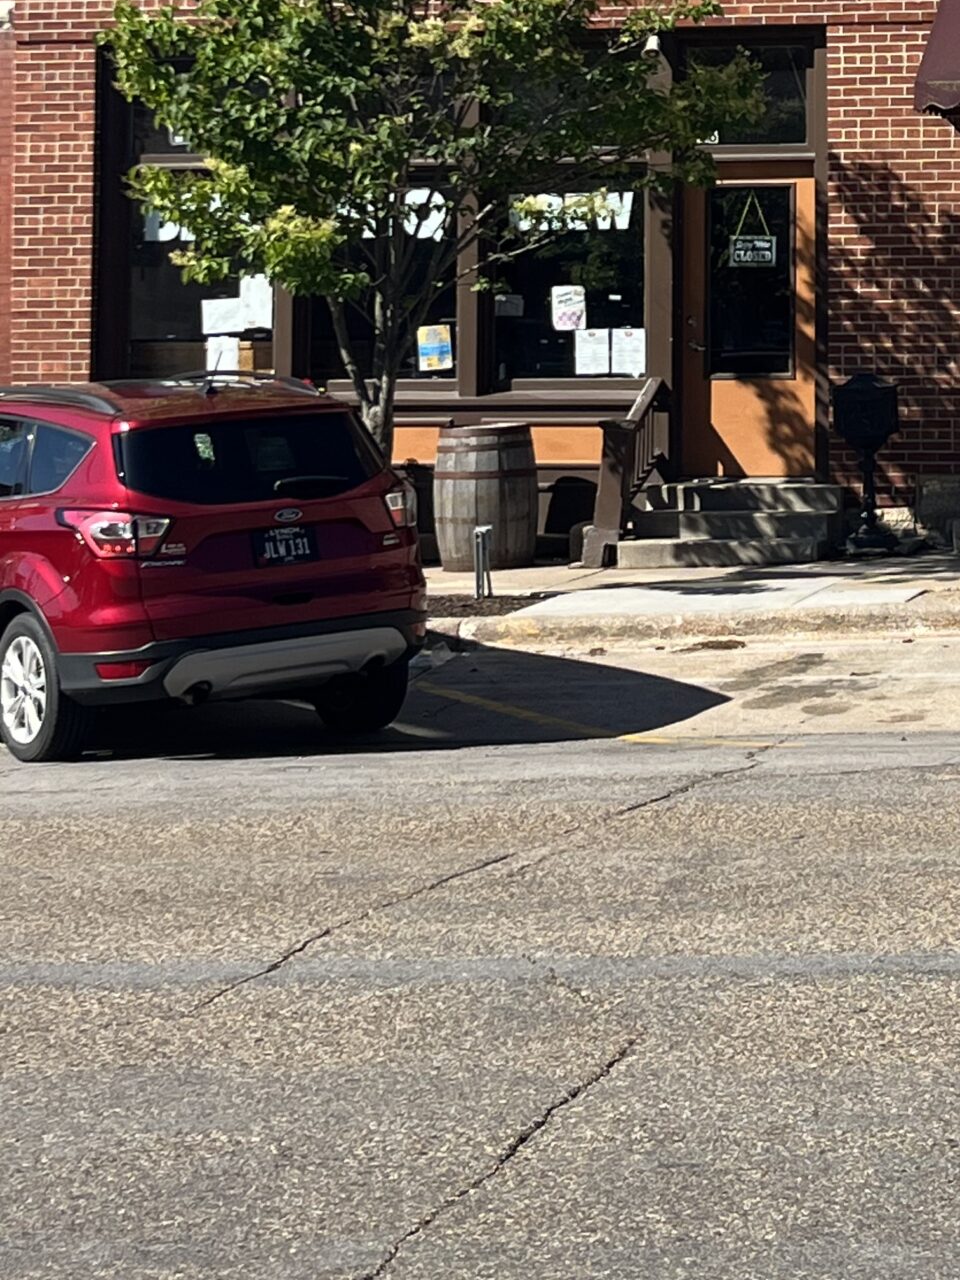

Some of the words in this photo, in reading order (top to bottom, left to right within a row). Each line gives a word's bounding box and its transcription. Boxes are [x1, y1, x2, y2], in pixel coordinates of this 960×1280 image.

[734, 250, 772, 262] CLOSED
[264, 540, 287, 560] JLW
[288, 536, 311, 556] 131
